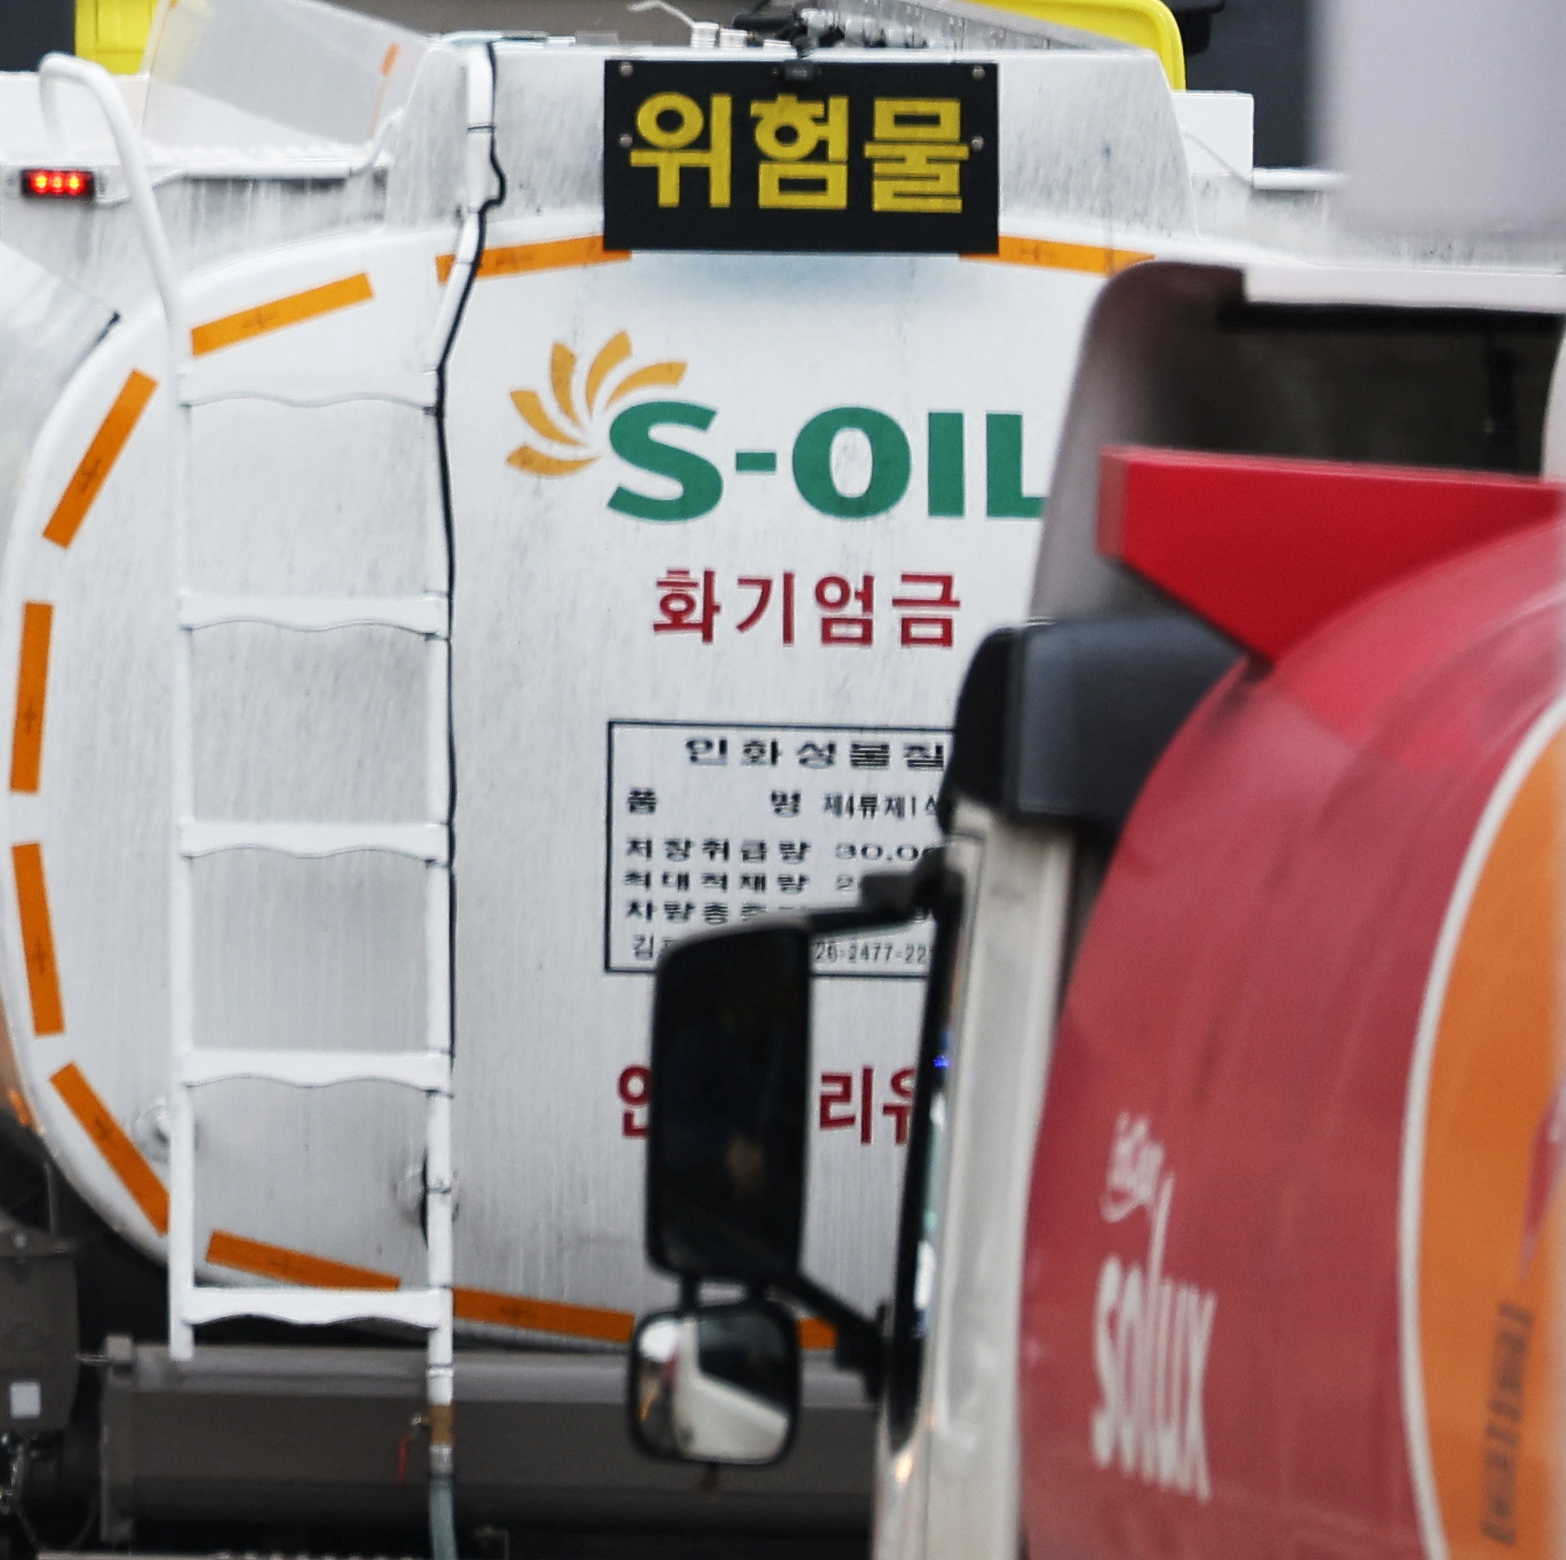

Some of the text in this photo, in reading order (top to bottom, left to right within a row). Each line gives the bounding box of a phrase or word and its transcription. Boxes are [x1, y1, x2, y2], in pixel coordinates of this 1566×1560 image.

[630, 91, 969, 213] 위험물
[606, 400, 1047, 522] S-OIL
[652, 569, 962, 647] 화기엄금
